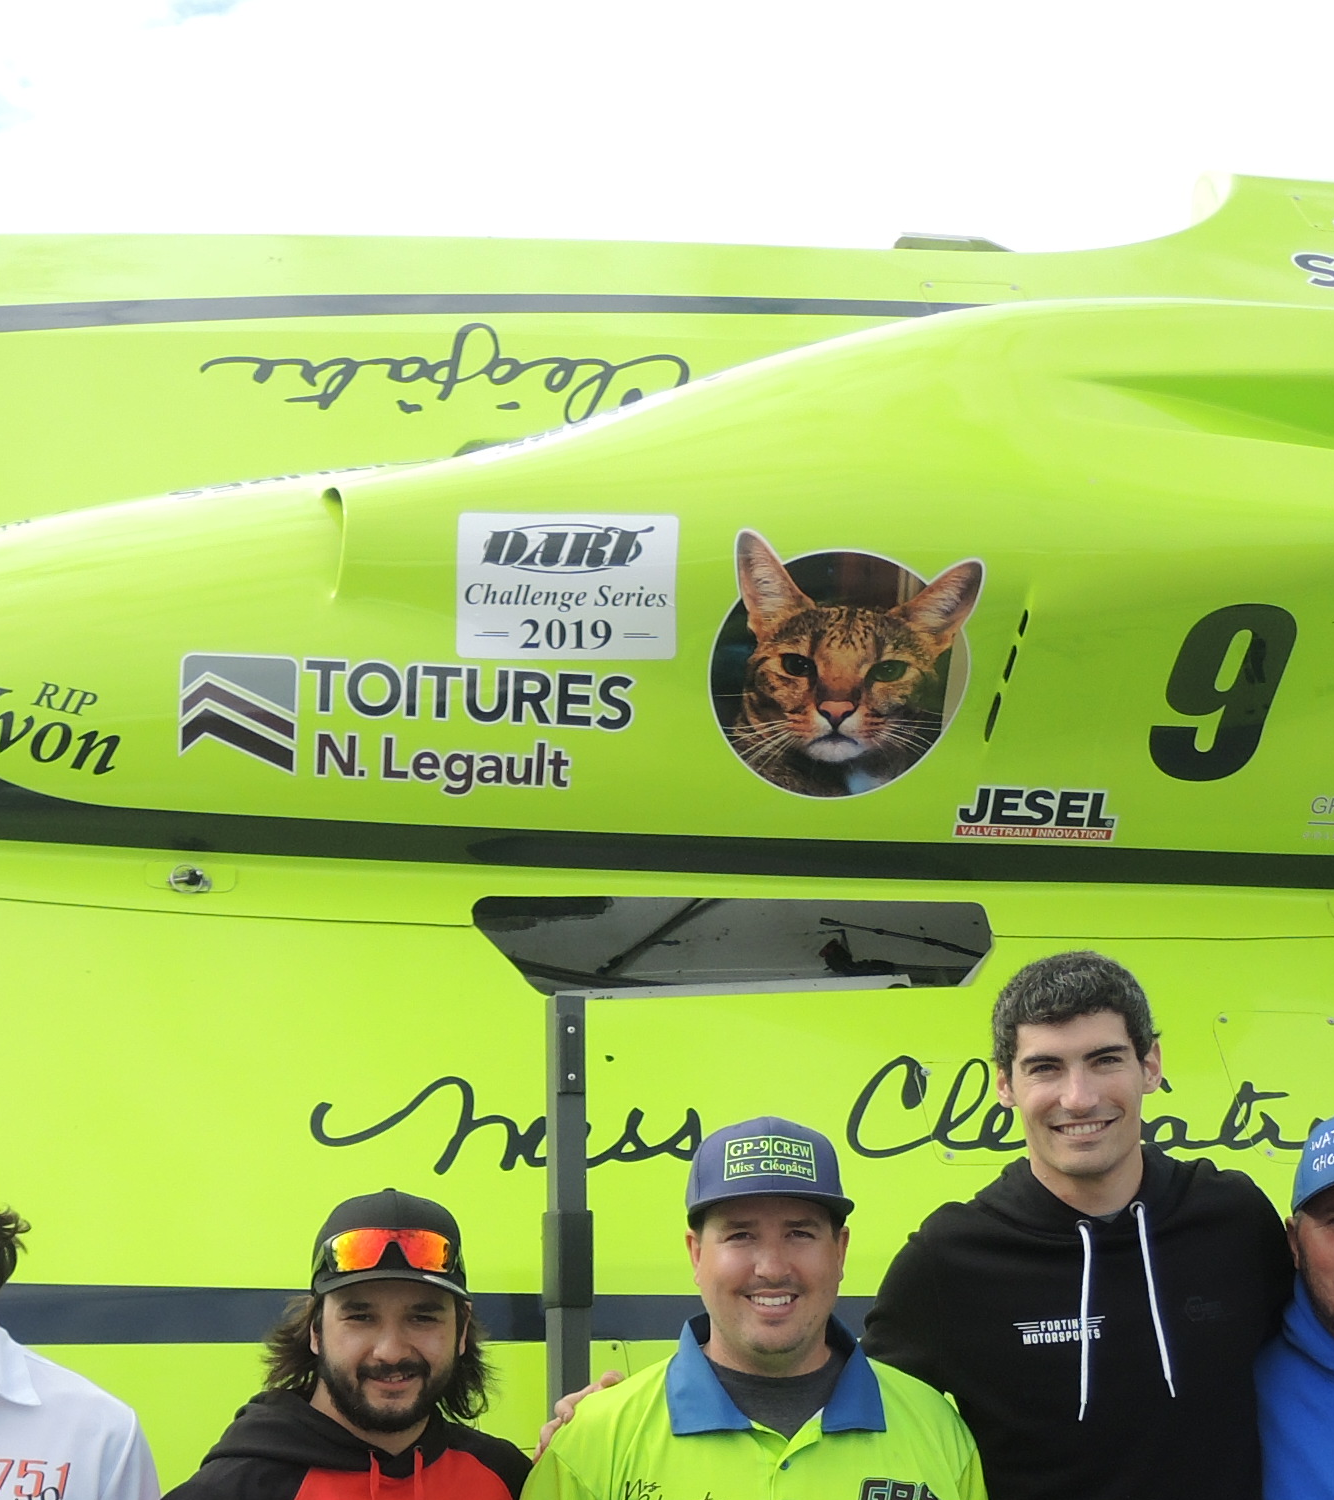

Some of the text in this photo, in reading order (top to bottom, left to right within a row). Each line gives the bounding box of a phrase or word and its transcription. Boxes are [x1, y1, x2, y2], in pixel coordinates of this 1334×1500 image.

[480, 524, 655, 569] DART
[464, 582, 668, 612] Challenge Series
[518, 618, 612, 651] 2019
[30, 681, 98, 717] RIP
[304, 658, 634, 731] TOITURES
[1149, 603, 1298, 782] 9
[316, 732, 569, 795] N. Legault
[959, 788, 1115, 828] JESEL
[961, 826, 1107, 840] VALVETRAIN INNOVATION
[730, 1140, 811, 1158] GP-9 CREW
[729, 1158, 813, 1176] Miss Cléopâtre
[1023, 1328, 1101, 1345] MOTORSPOTS
